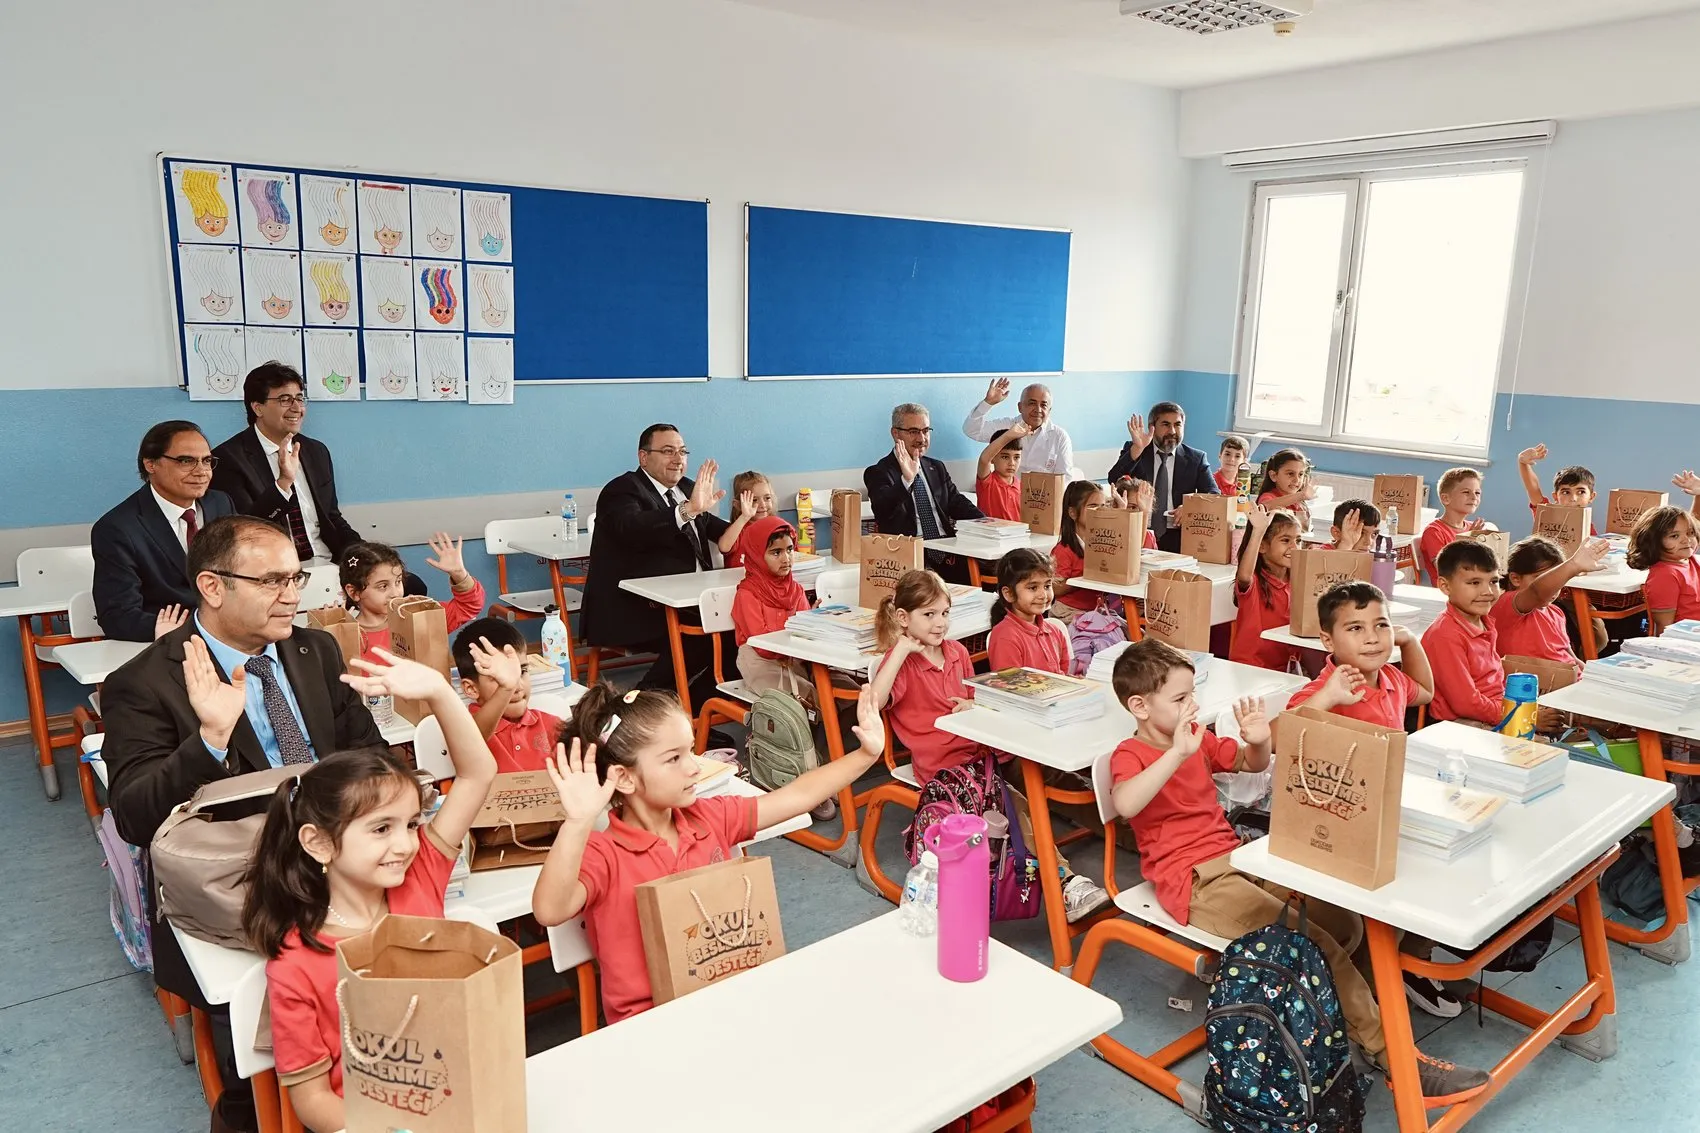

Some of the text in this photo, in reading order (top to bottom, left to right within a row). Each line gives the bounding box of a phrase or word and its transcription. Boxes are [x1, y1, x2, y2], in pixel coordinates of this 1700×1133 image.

[875, 559, 900, 571] OKUL
[1303, 758, 1354, 787] OKUL
[699, 908, 754, 939] OKUL
[704, 947, 762, 981] DESTEĞİ
[350, 1027, 424, 1064] OKUL
[357, 1078, 433, 1116] DESTEĞİ
